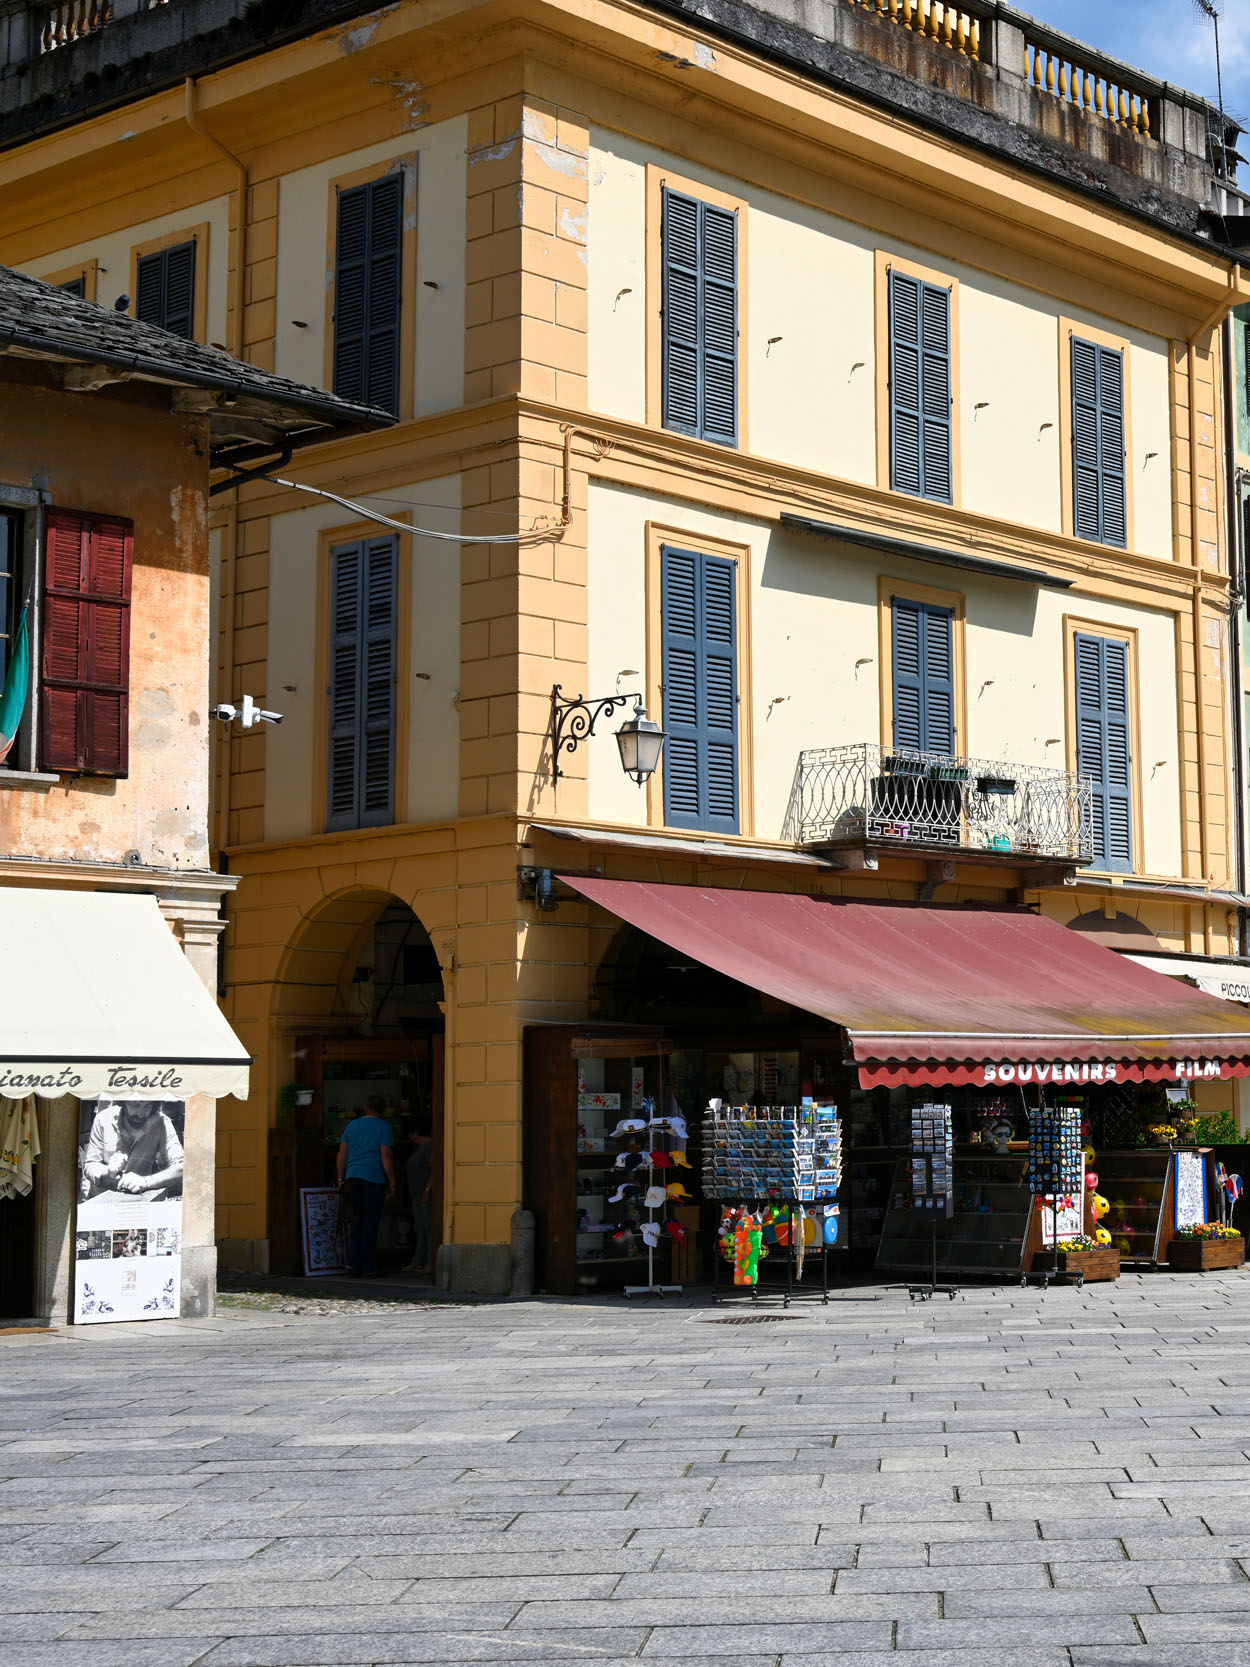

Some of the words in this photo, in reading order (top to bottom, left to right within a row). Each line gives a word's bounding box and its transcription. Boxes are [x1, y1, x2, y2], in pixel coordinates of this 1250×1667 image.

[107, 1067, 183, 1088] Tessile
[984, 1062, 1117, 1081] SOUVENIRS
[1175, 1060, 1221, 1077] FILM
